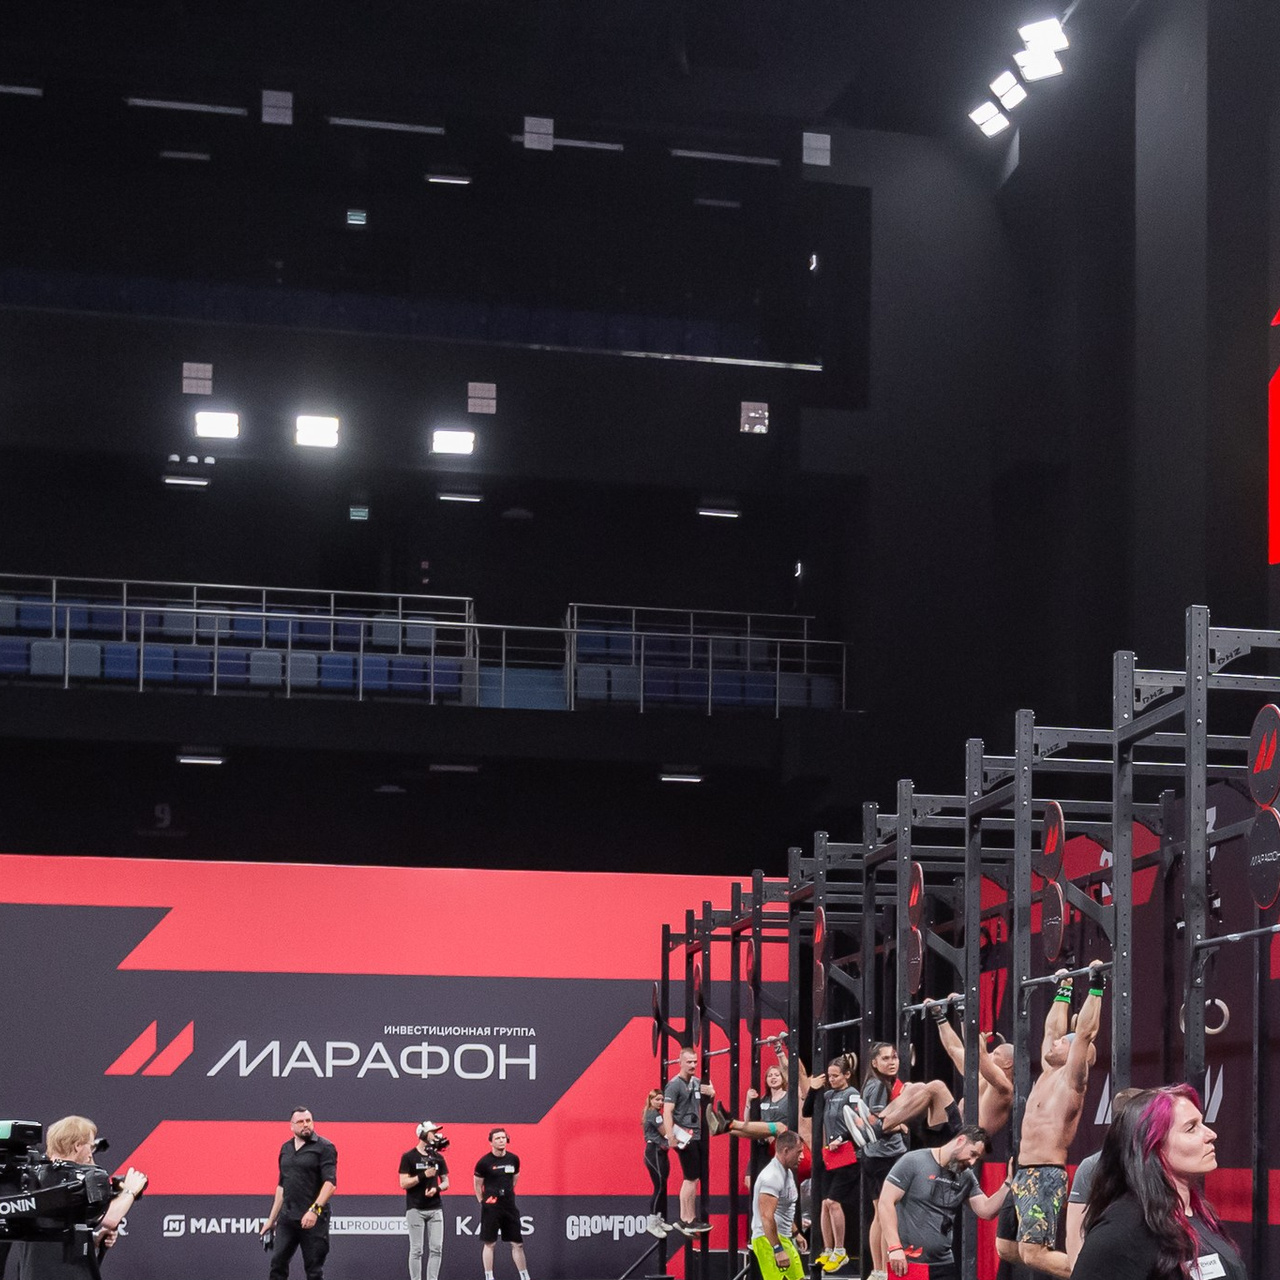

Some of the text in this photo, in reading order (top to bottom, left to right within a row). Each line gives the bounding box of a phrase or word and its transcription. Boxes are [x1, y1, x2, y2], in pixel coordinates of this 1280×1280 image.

[384, 1025, 536, 1037] ИНВЕСТИЦИОННАЯ ГРУППА
[207, 1039, 536, 1080] МАРАФОН
[0, 1198, 36, 1215] ONIN
[329, 1220, 409, 1231] ELLPRODUCTS
[566, 1215, 650, 1240] GROWFOO
